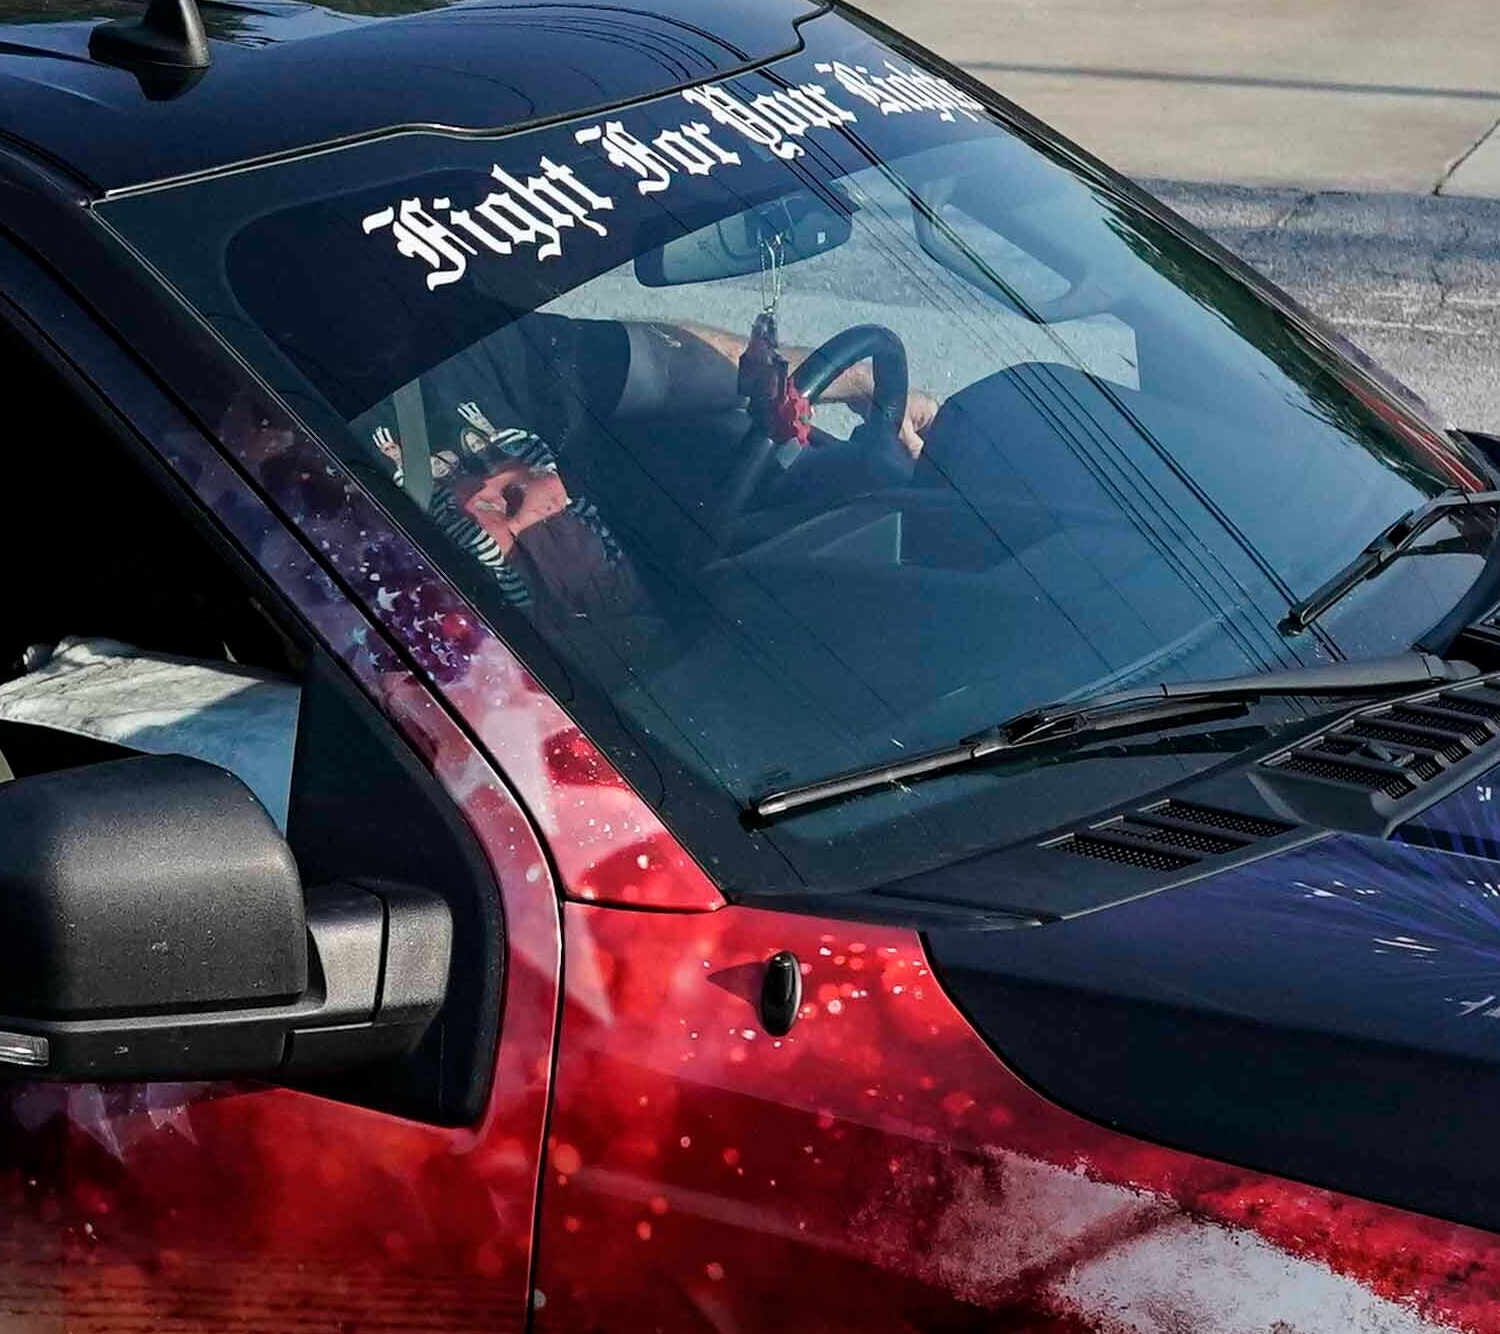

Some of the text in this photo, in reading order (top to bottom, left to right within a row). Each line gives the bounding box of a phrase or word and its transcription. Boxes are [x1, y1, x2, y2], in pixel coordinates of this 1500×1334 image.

[362, 156, 613, 291] Fight
[575, 120, 741, 195] For
[682, 82, 858, 160] Your
